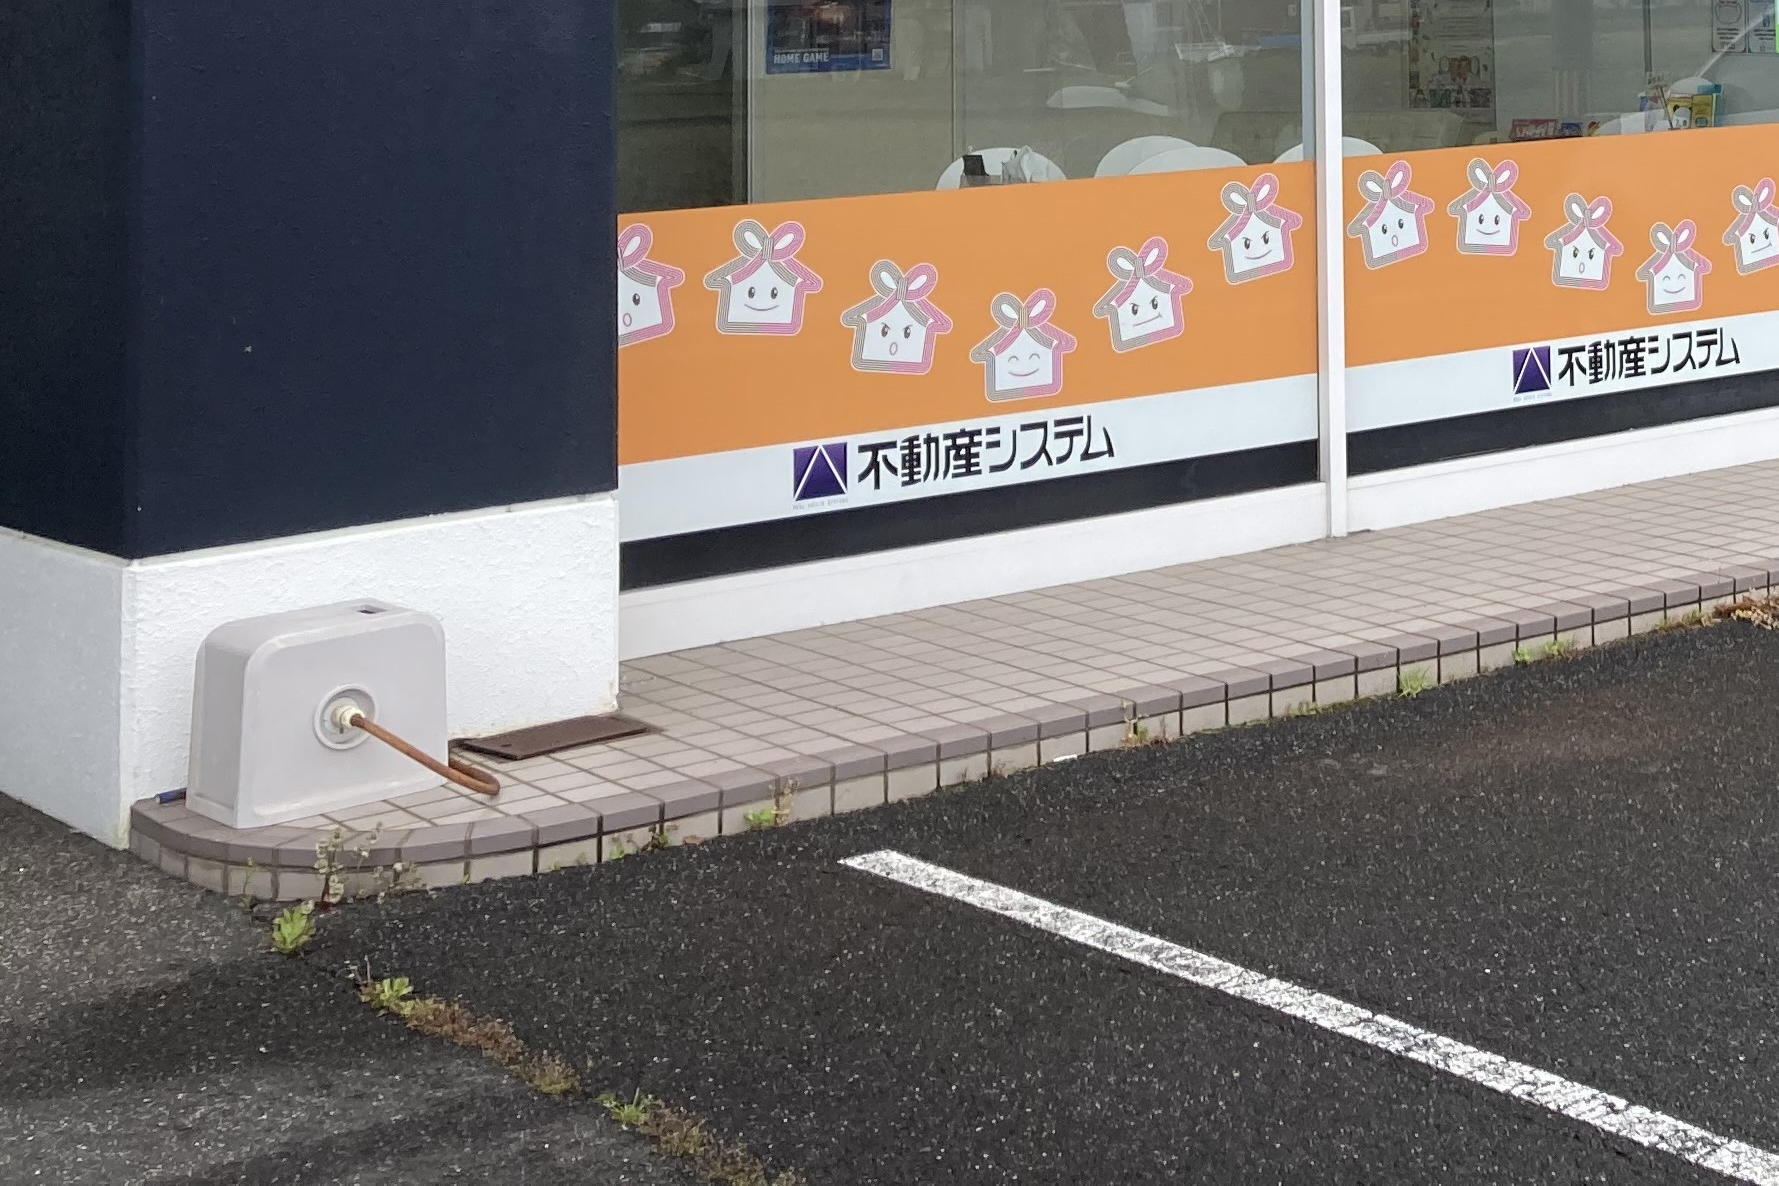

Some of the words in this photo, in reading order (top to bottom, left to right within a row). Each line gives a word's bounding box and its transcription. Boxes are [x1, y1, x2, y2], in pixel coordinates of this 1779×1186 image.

[1558, 327, 1740, 386] 不動産システム
[857, 415, 1115, 490] 不動産システム
